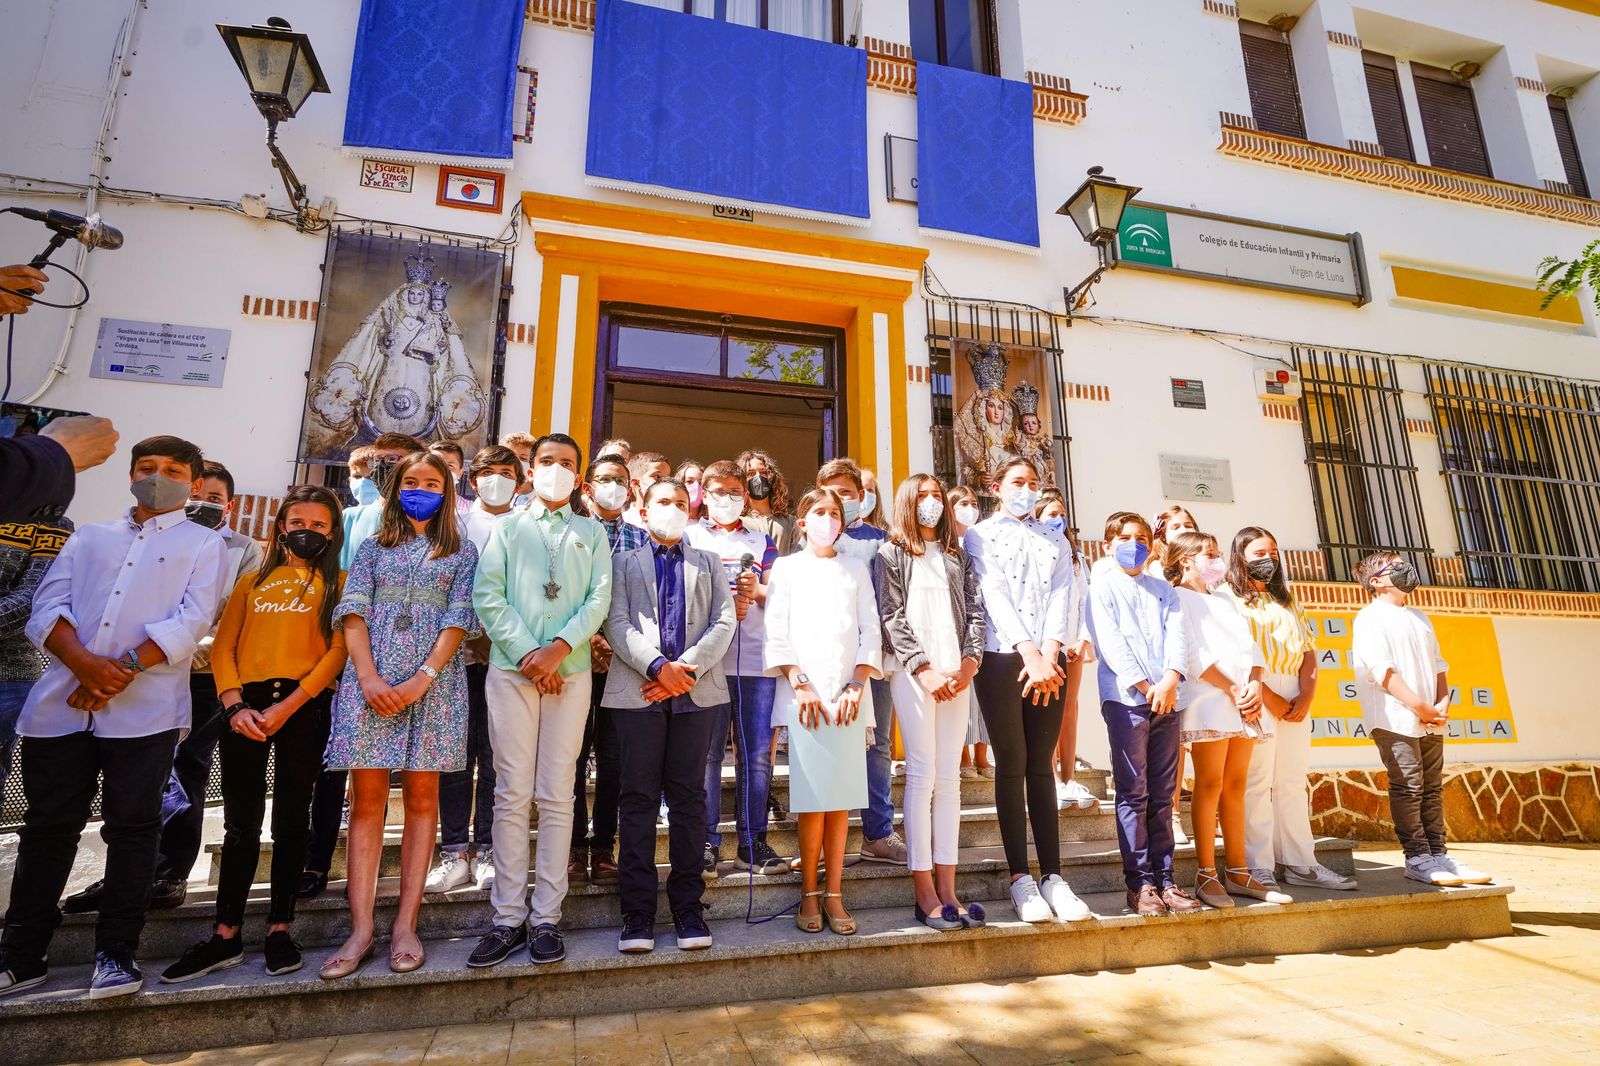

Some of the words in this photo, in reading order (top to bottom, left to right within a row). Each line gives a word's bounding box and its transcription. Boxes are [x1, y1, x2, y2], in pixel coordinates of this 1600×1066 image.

[375, 163, 408, 174] ESCUELA:
[382, 173, 407, 181] ESPACIO
[1199, 233, 1228, 247] Colegio
[1229, 239, 1239, 248] de
[1240, 240, 1278, 254] Educación
[1279, 246, 1304, 258] Infantil
[1306, 252, 1310, 260] y
[1311, 251, 1342, 264] Primaria
[1289, 264, 1314, 279] Virgen
[1315, 270, 1324, 279] de
[1326, 271, 1345, 283] Luna
[254, 596, 313, 613] Smile
